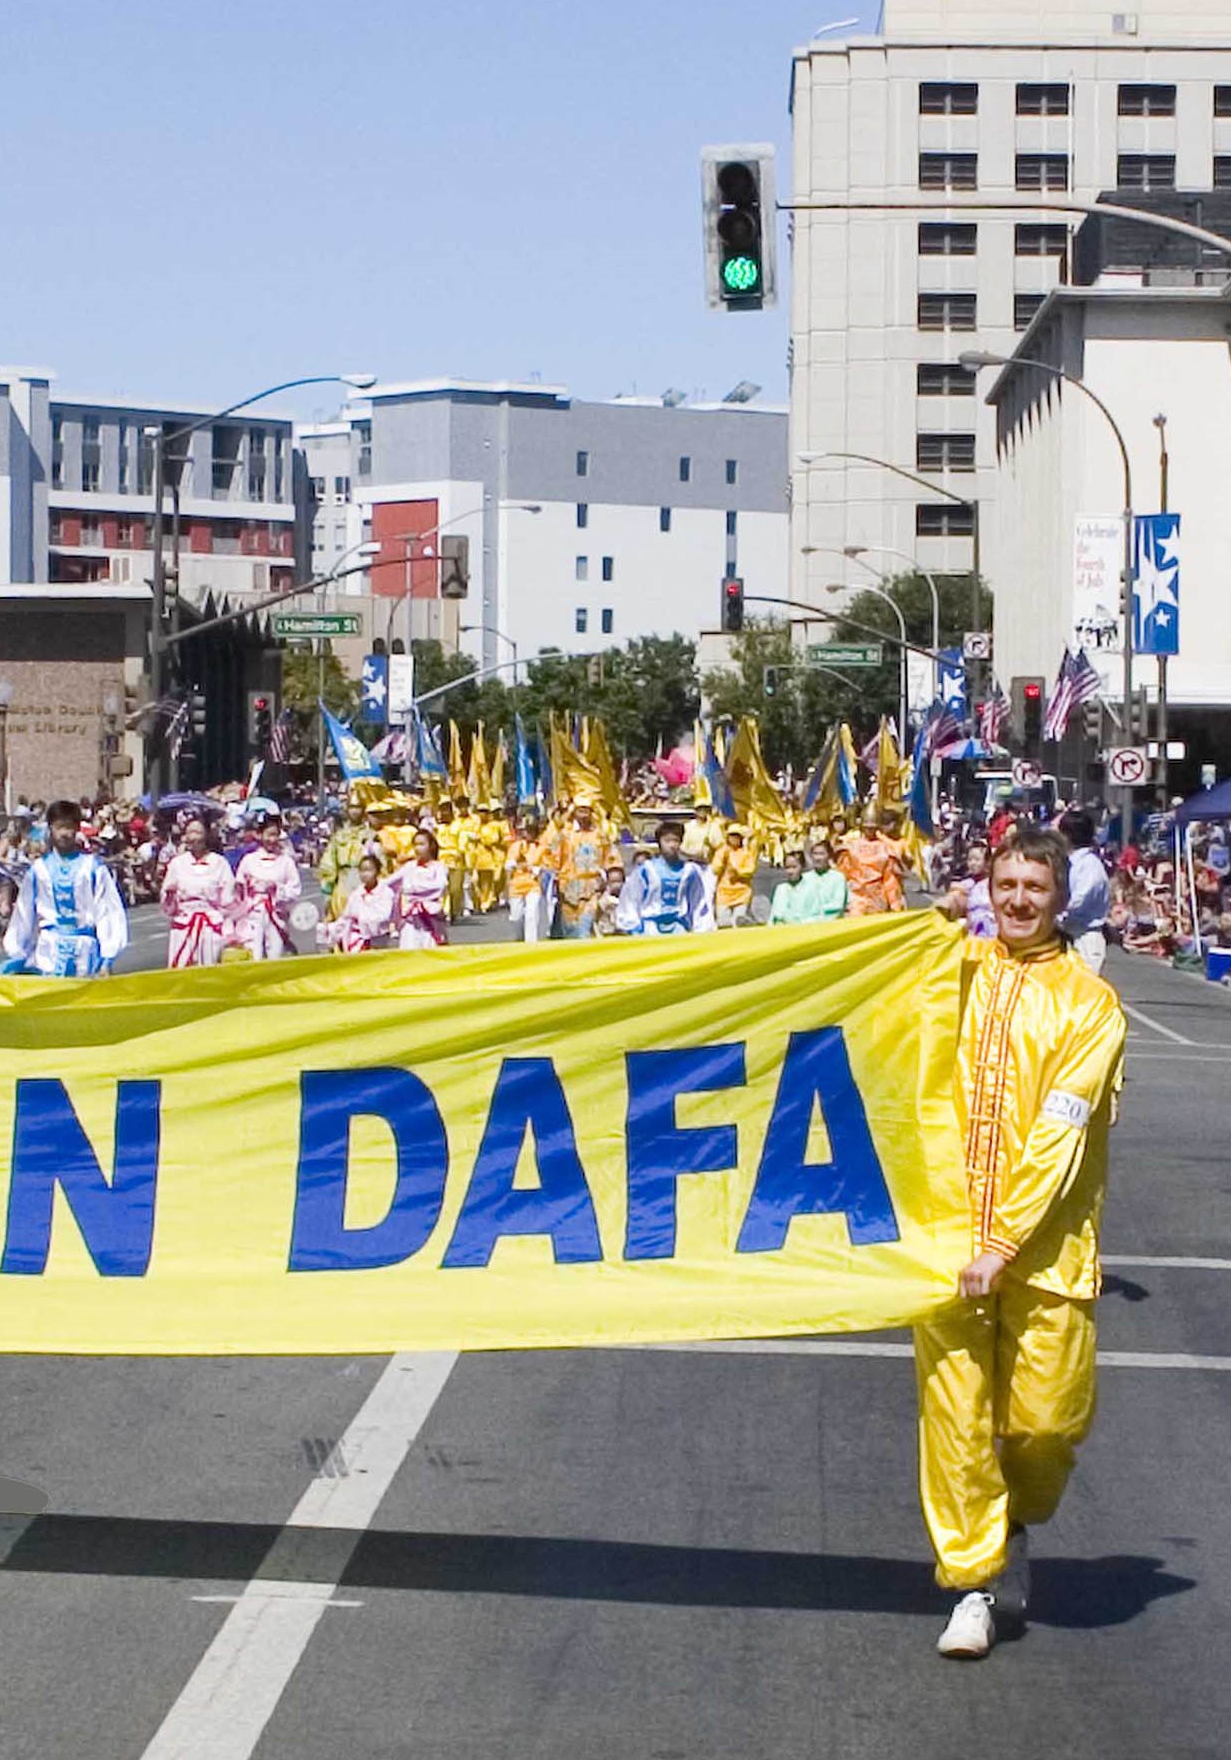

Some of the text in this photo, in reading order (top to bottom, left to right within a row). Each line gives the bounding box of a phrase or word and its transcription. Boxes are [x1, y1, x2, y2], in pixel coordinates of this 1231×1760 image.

[283, 618, 358, 632] Hamilton St
[1047, 1094, 1082, 1119] 220
[287, 1025, 901, 1272] DAFA
